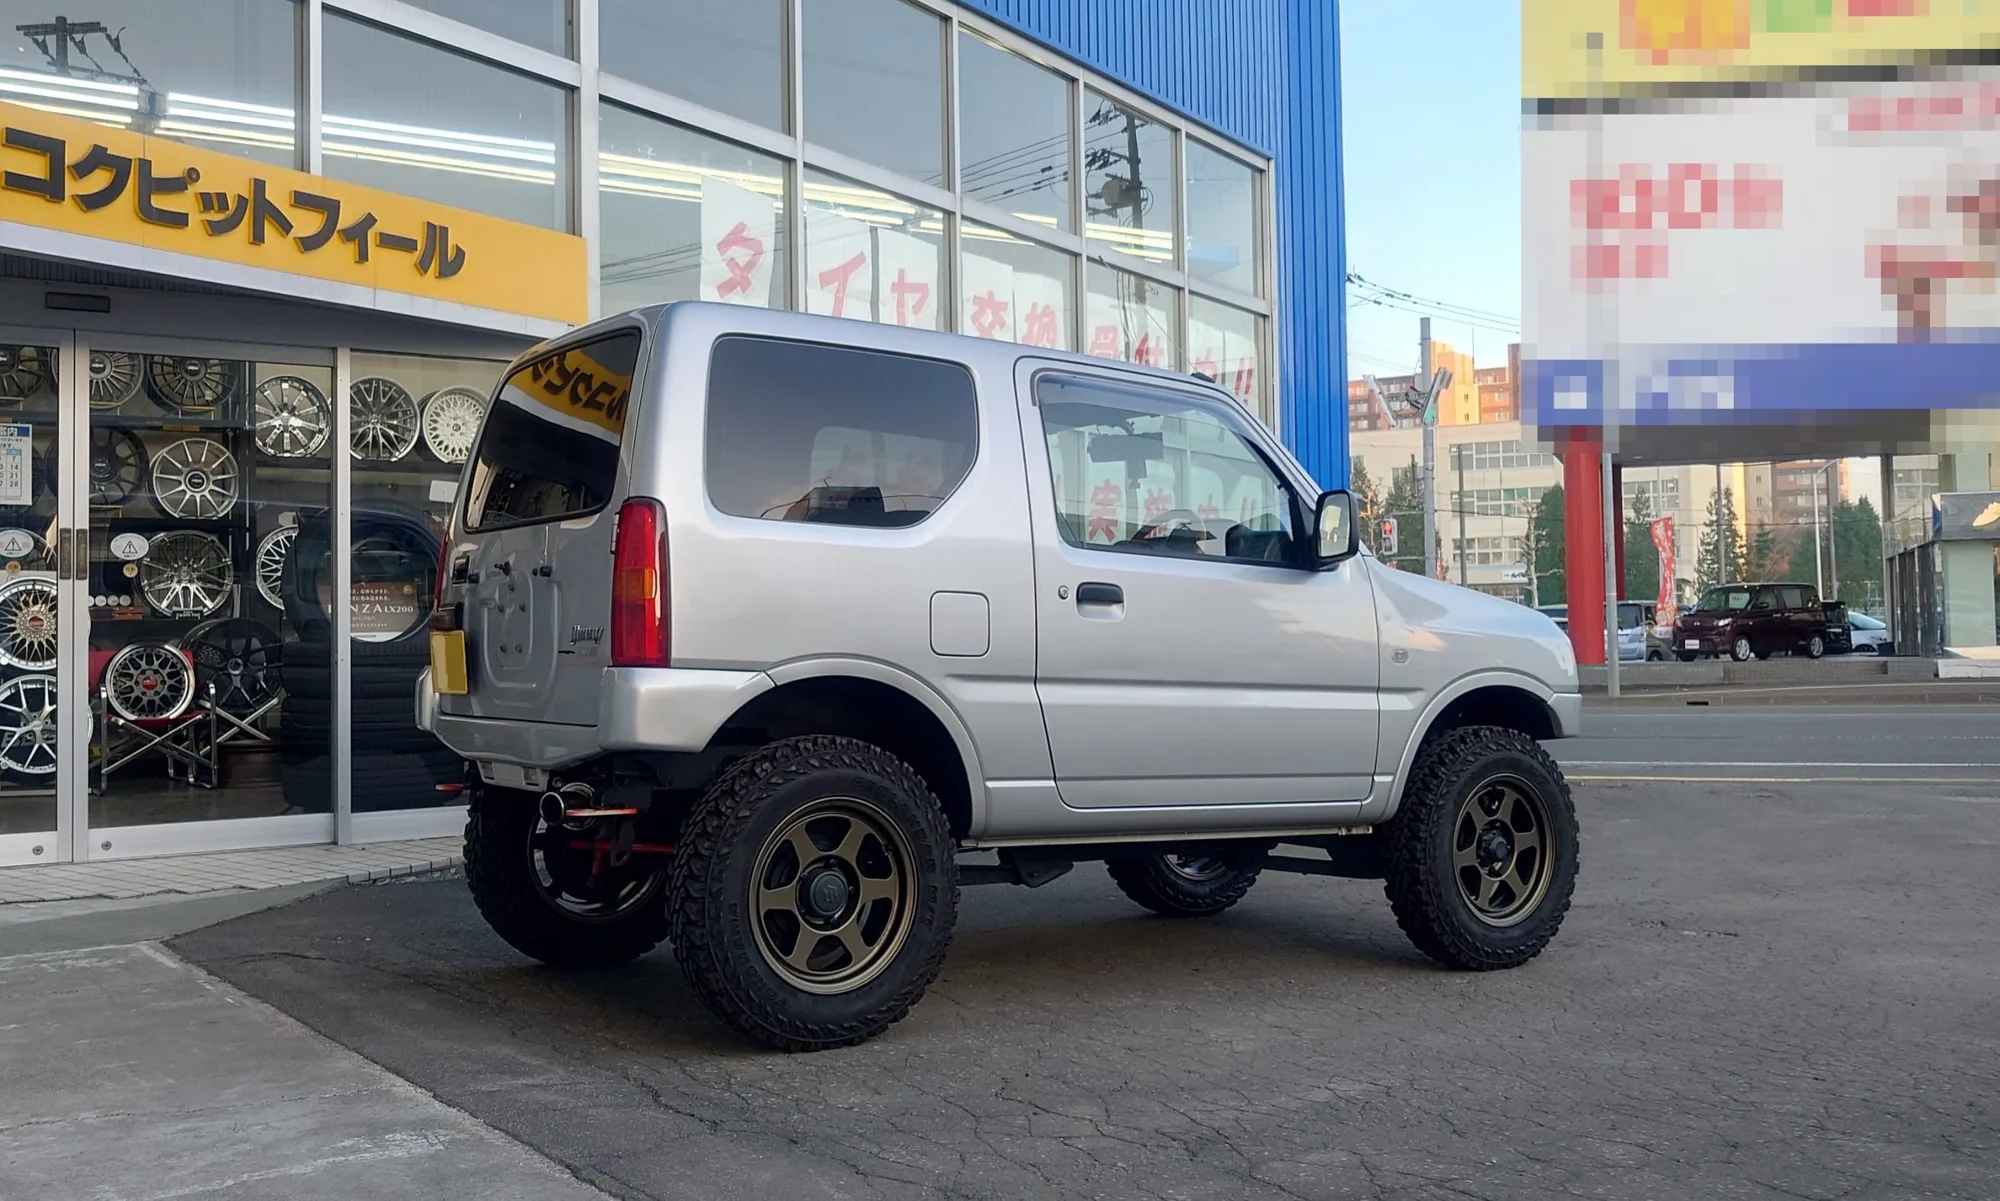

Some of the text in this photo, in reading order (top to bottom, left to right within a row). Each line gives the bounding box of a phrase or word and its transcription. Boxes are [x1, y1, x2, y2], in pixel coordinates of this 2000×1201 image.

[2, 126, 466, 278] コクピットフィール
[385, 605, 413, 613] LX200
